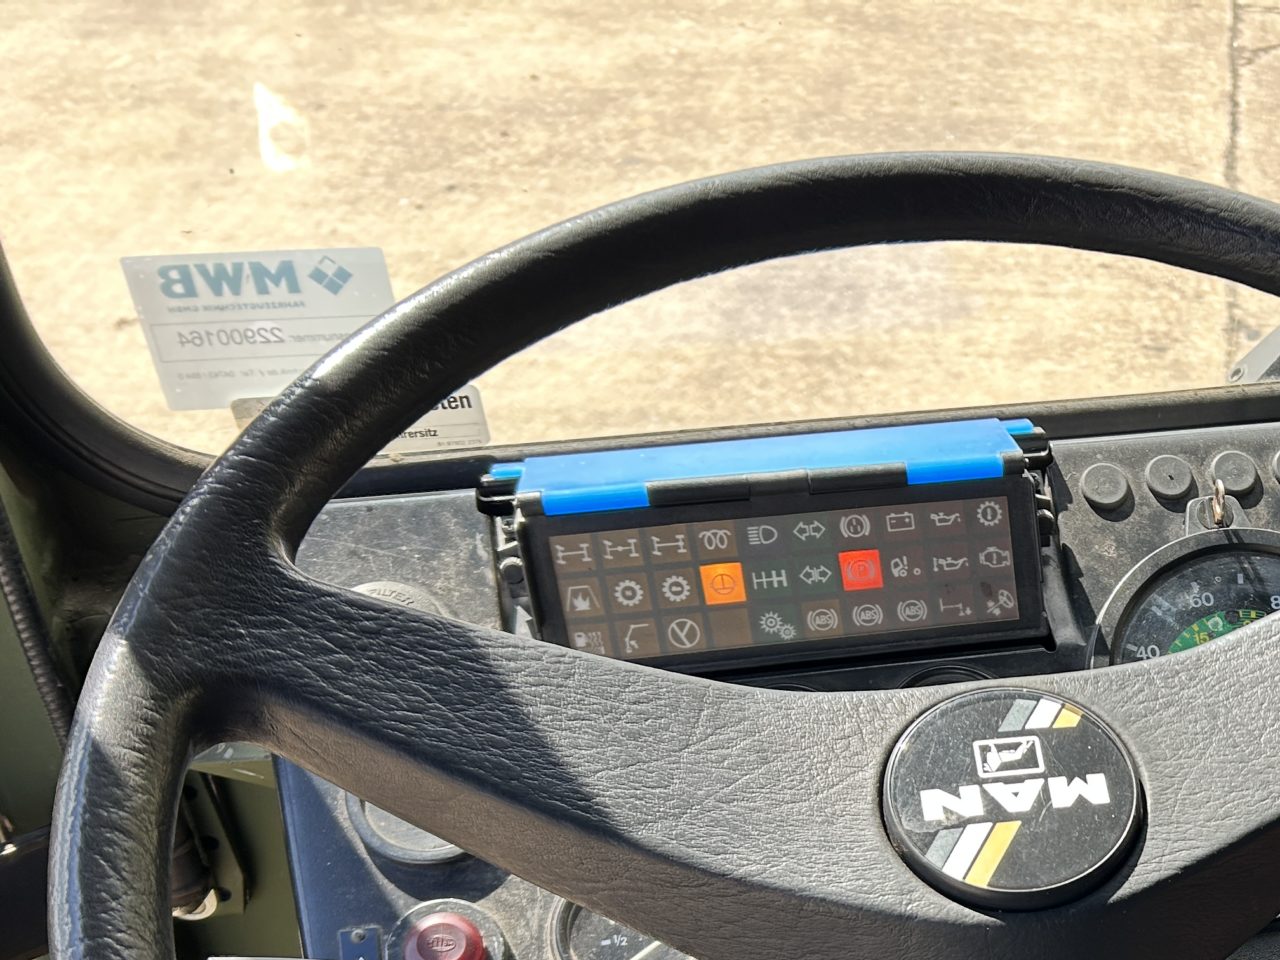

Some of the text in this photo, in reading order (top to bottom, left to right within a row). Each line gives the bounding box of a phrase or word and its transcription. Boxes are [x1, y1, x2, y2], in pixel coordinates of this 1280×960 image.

[400, 428, 439, 439] rersitz
[1190, 592, 1214, 608] 60
[1136, 644, 1161, 660] 40
[919, 773, 1111, 822] MAN
[612, 934, 628, 946] 1/2
